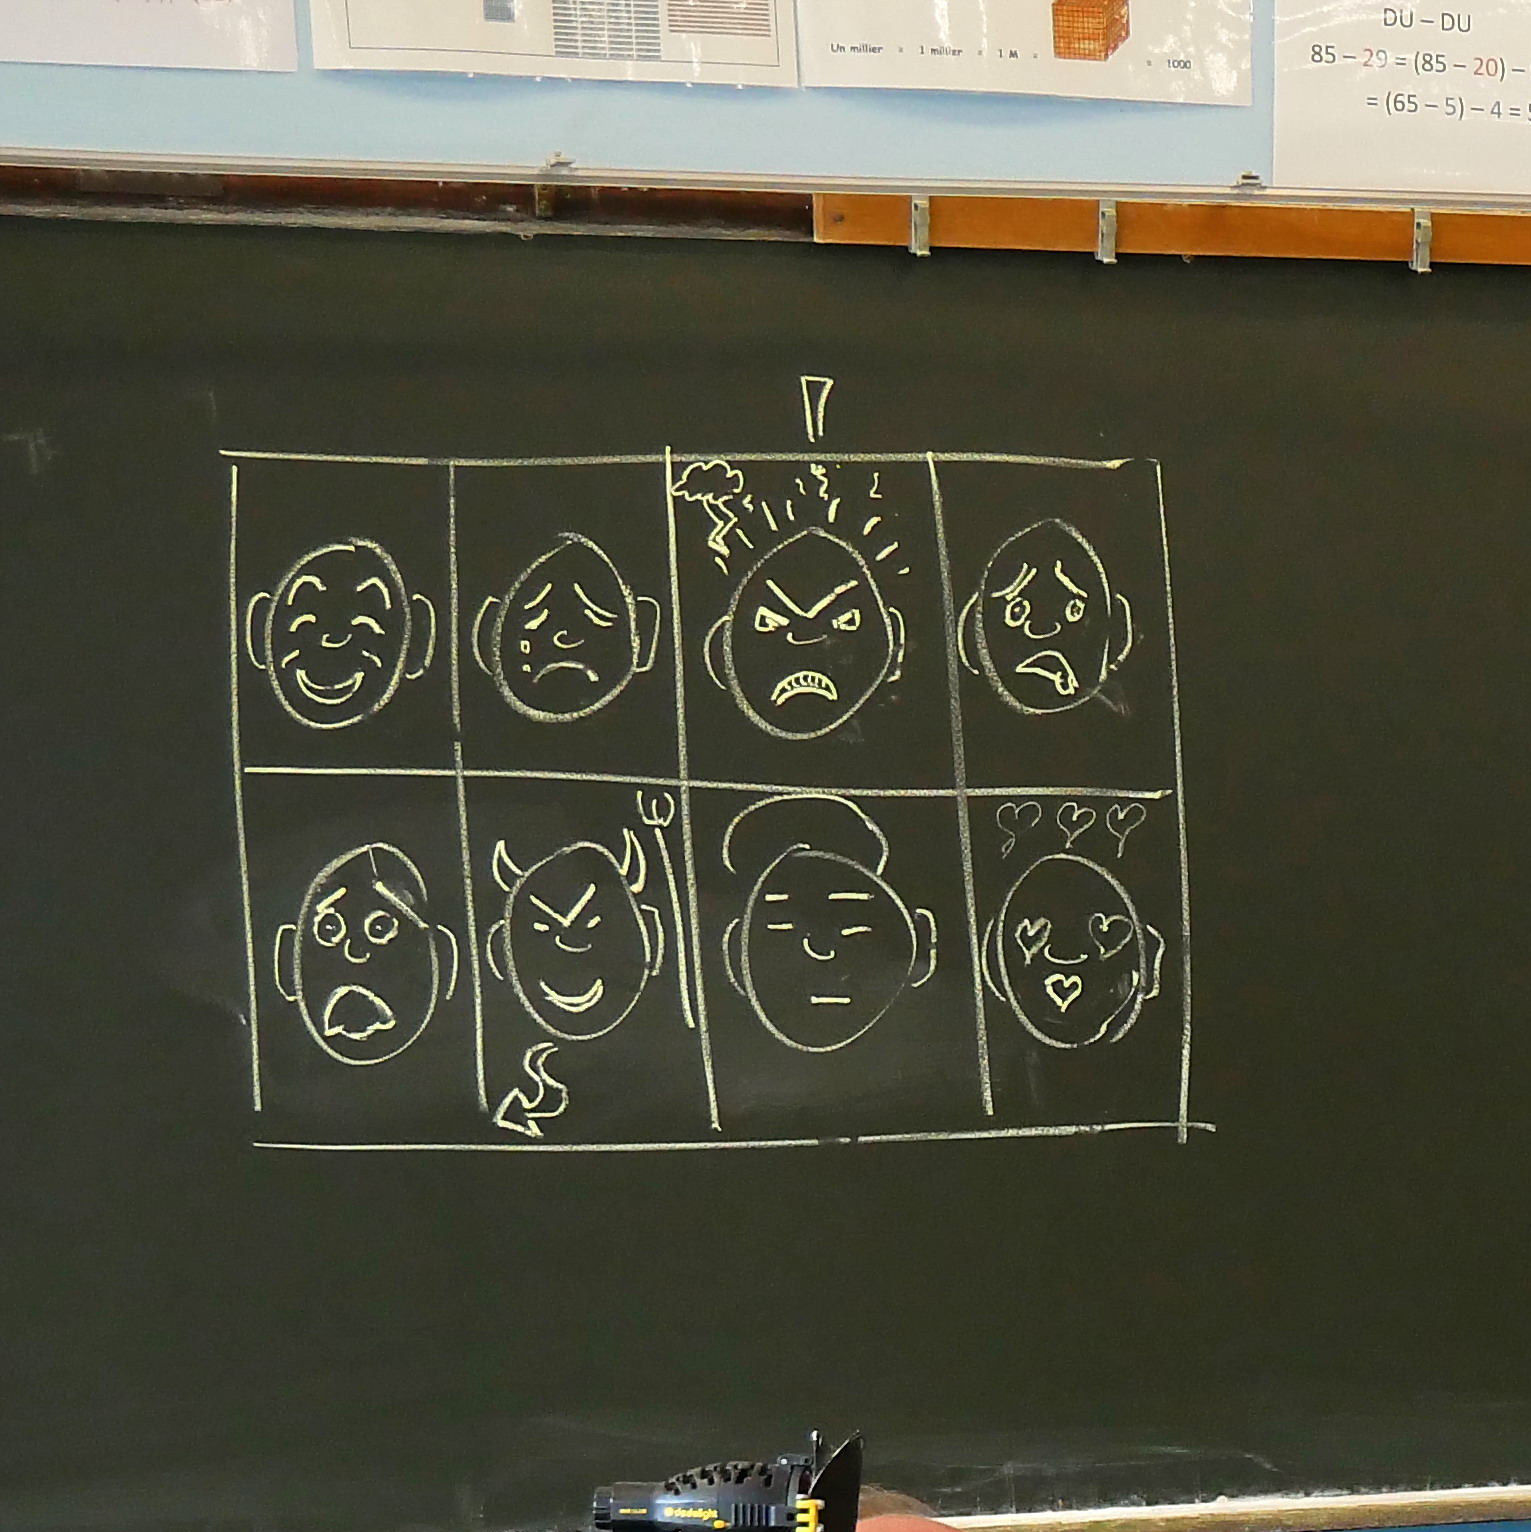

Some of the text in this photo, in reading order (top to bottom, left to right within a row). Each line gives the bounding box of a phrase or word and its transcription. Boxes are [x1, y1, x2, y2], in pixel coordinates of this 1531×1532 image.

[1383, 7, 1414, 28] DU
[1441, 12, 1472, 32] DU
[831, 43, 846, 53] Un
[850, 43, 883, 54] millier
[930, 46, 963, 57] millier
[1009, 50, 1019, 59] M
[1166, 58, 1192, 70] 1000
[1310, 44, 1336, 64] 85
[1362, 48, 1388, 68] 29
[1395, 56, 1407, 66] =
[1414, 51, 1447, 76] (85
[1473, 57, 1506, 82] 20)
[1385, 91, 1419, 116] (65
[1444, 97, 1465, 121] 5)
[1490, 101, 1503, 119] 4
